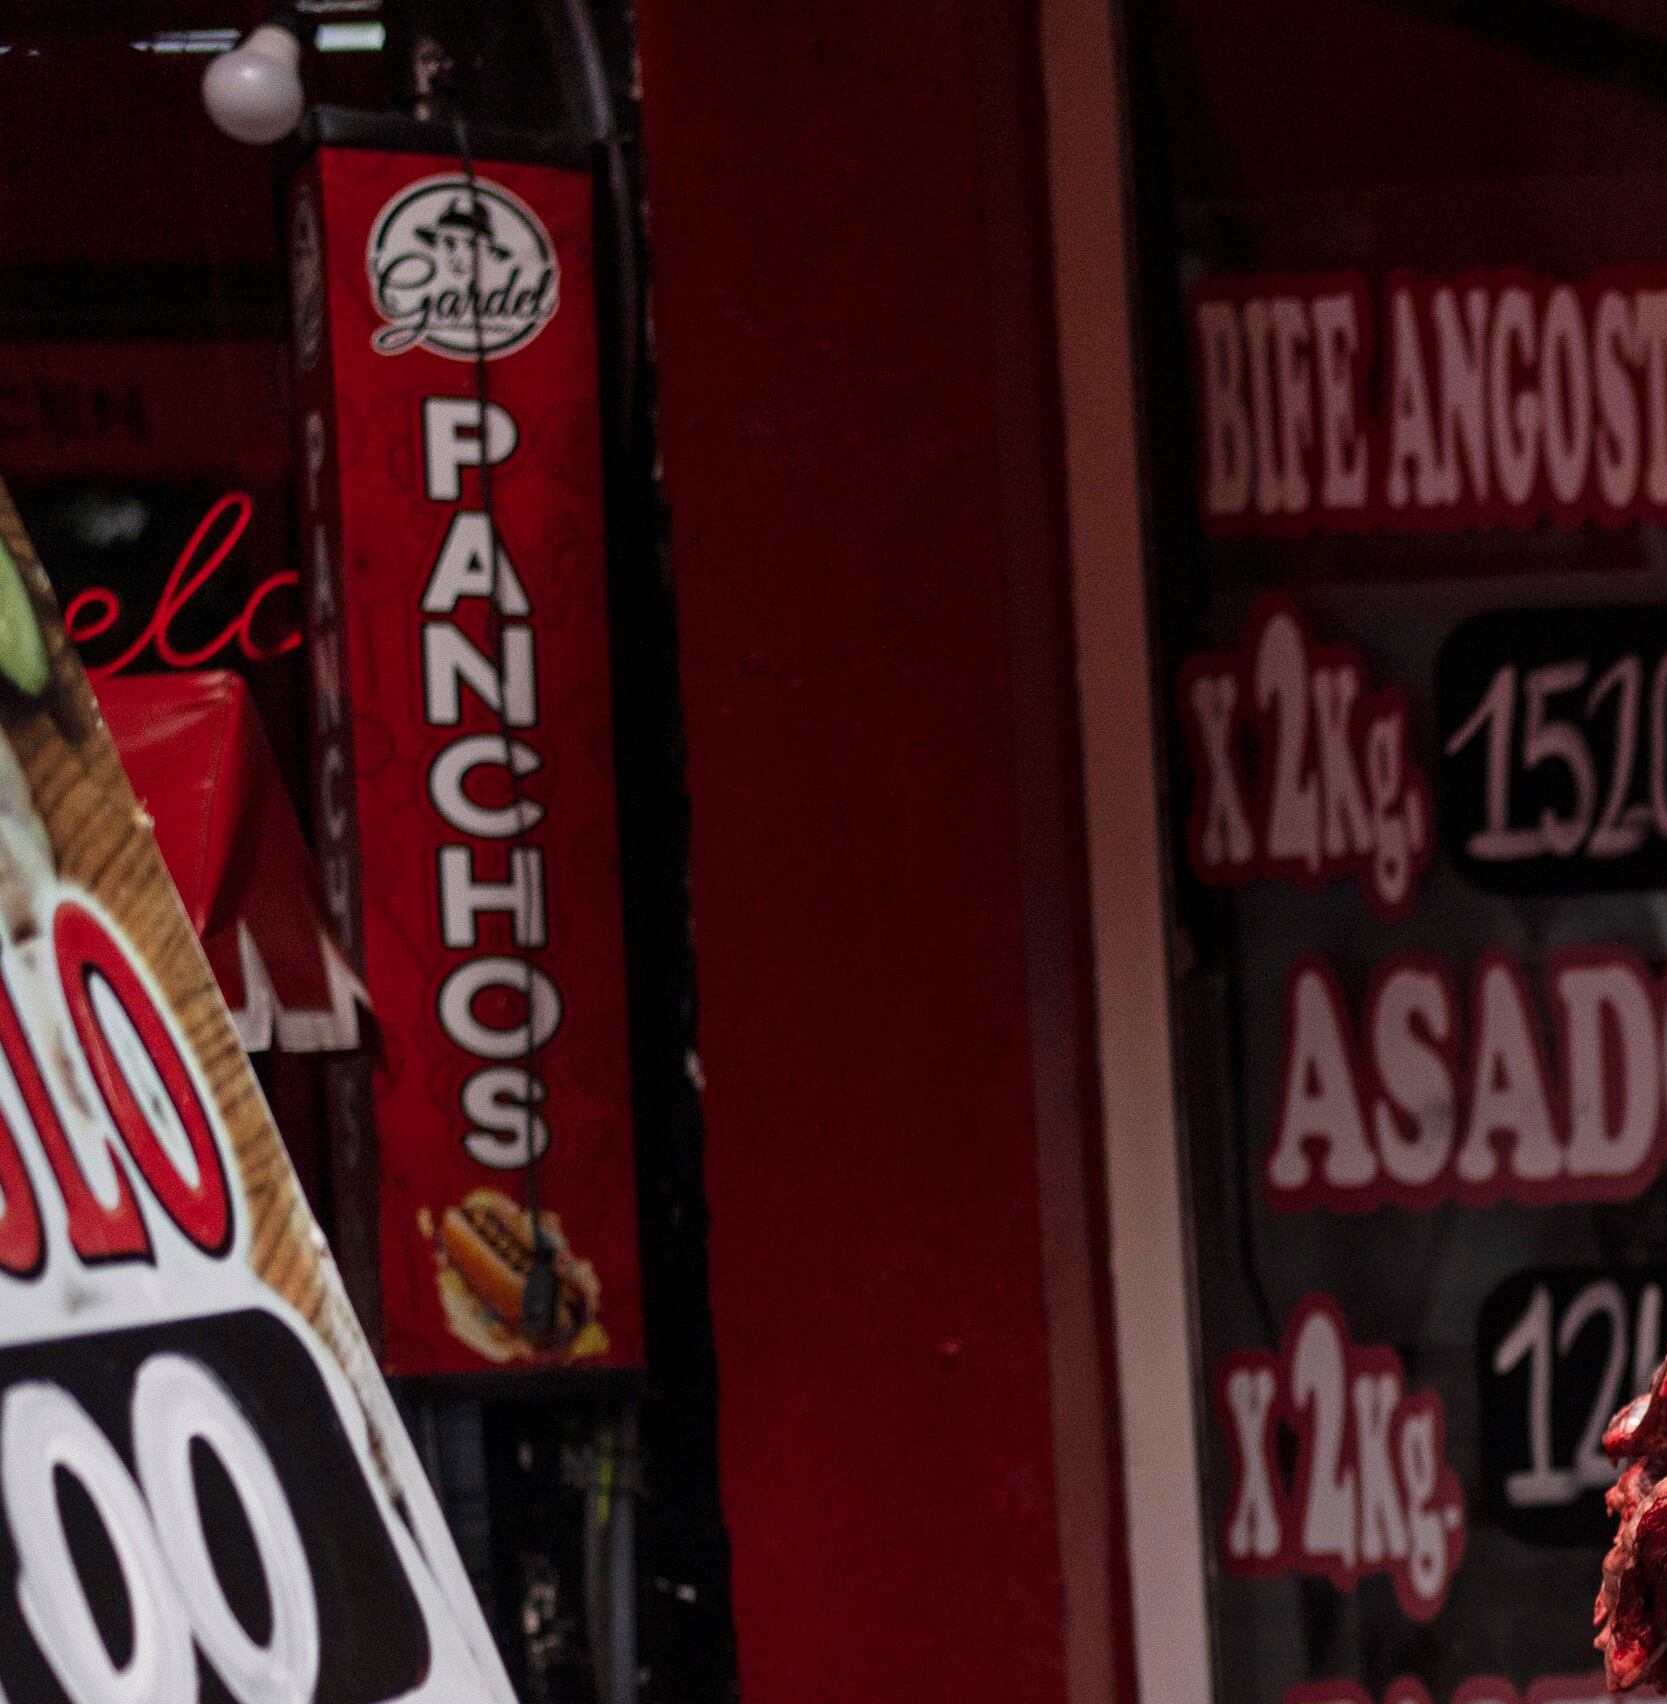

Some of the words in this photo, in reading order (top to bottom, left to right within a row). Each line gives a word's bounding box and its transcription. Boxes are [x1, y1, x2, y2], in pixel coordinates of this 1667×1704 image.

[375, 252, 555, 350] Gardel
[1201, 293, 1366, 515] BIFE
[421, 397, 563, 1169] PANCHOS
